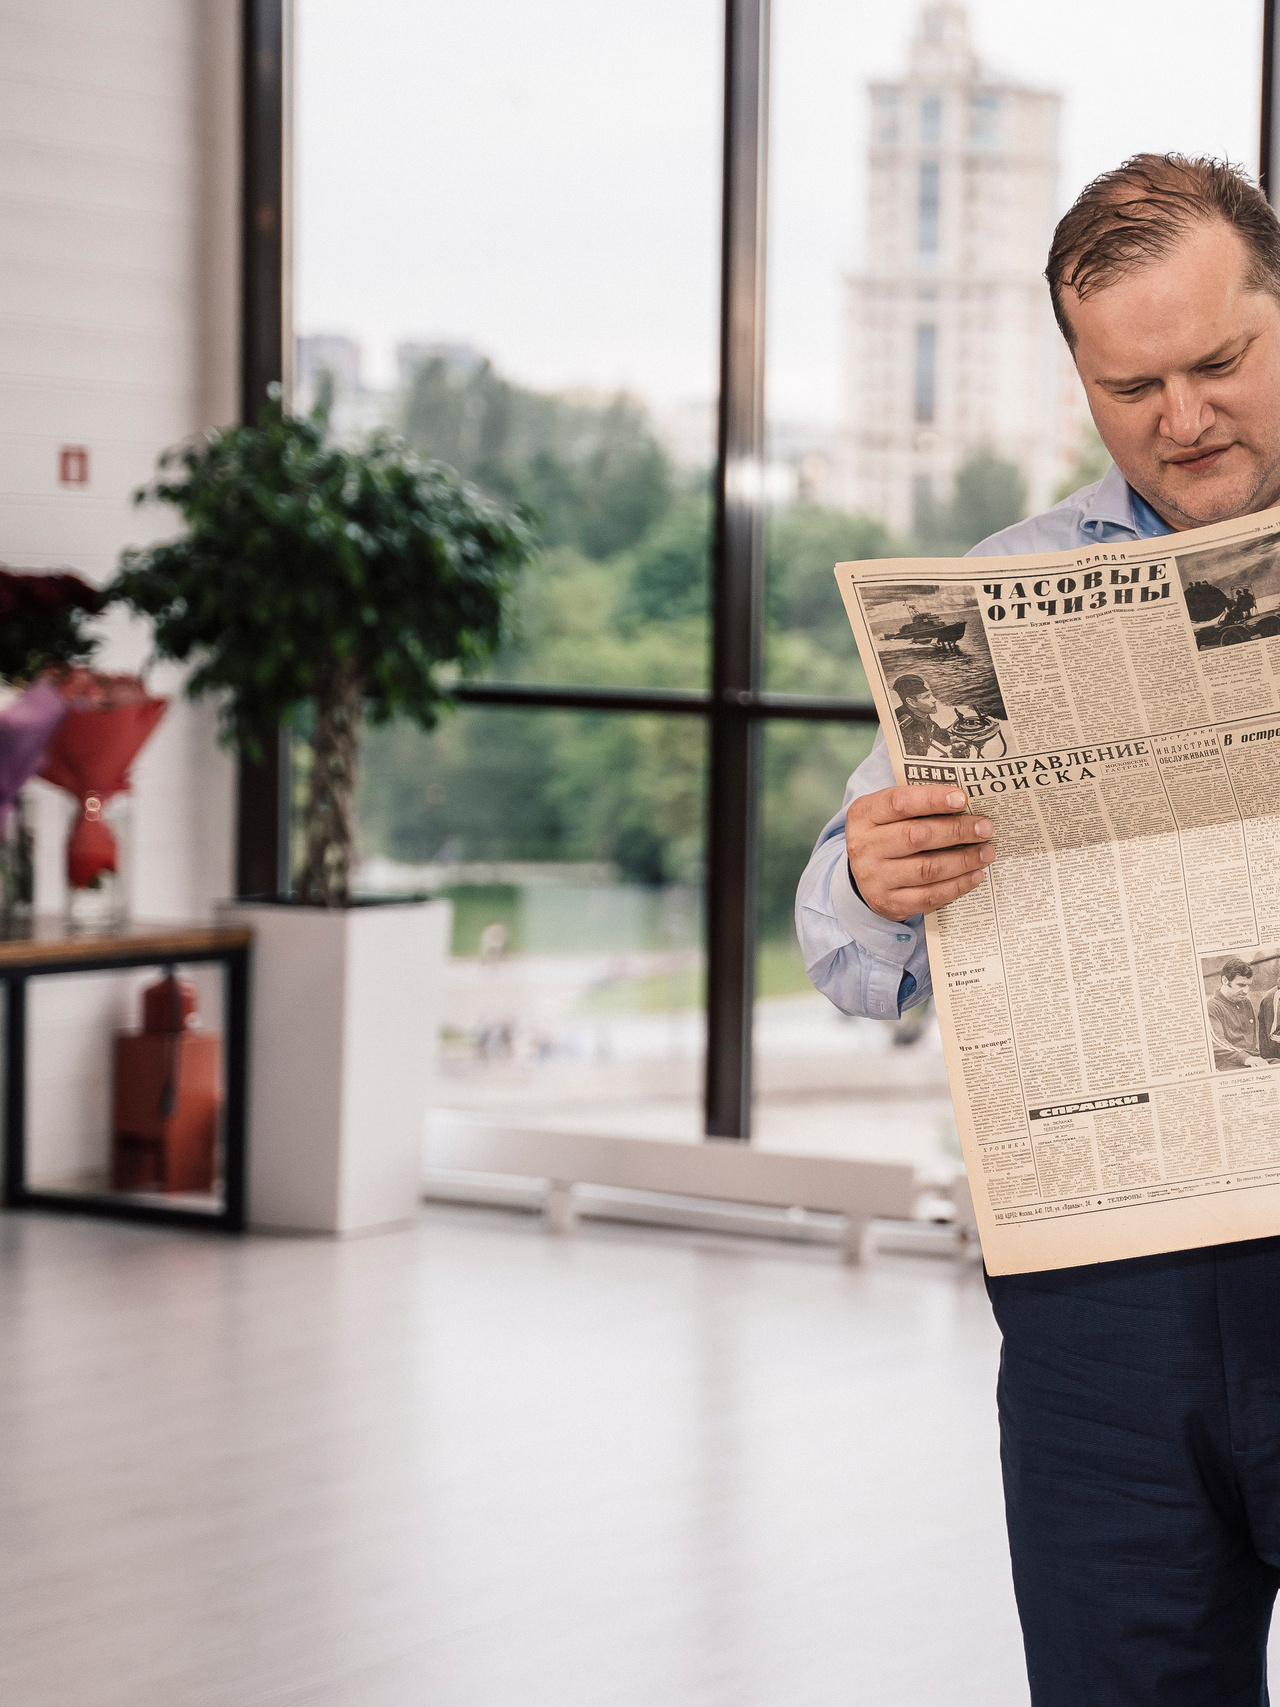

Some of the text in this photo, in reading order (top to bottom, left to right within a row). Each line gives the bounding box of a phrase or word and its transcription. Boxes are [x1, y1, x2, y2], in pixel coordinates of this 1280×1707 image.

[1076, 554, 1126, 567] ПРАВДА
[982, 563, 1168, 600] ЧАСОВЫЕ
[988, 582, 1172, 621] ОТЧИЗНЫ
[1030, 608, 1135, 628] Будни морских пограничников
[1154, 728, 1214, 743] ВЫСТАВКИ
[1224, 734, 1233, 746] В
[1156, 738, 1216, 755] ИНДУСТРИЯ
[961, 741, 1150, 782] НАПРАВЛЕНИЕ
[1105, 758, 1148, 768] МОСКОВСКИЕ
[1159, 748, 1220, 765] ОБСЛУЖИВАНИЯ
[908, 766, 956, 780] ДЕНЬ
[1105, 763, 1150, 774] ГАСТРОЛИ
[966, 767, 1096, 798] ПОИСКА
[946, 966, 986, 978] Театр едет
[1039, 1096, 1138, 1118] СПРАВКИ
[983, 1142, 1026, 1152] ХРОНИКА
